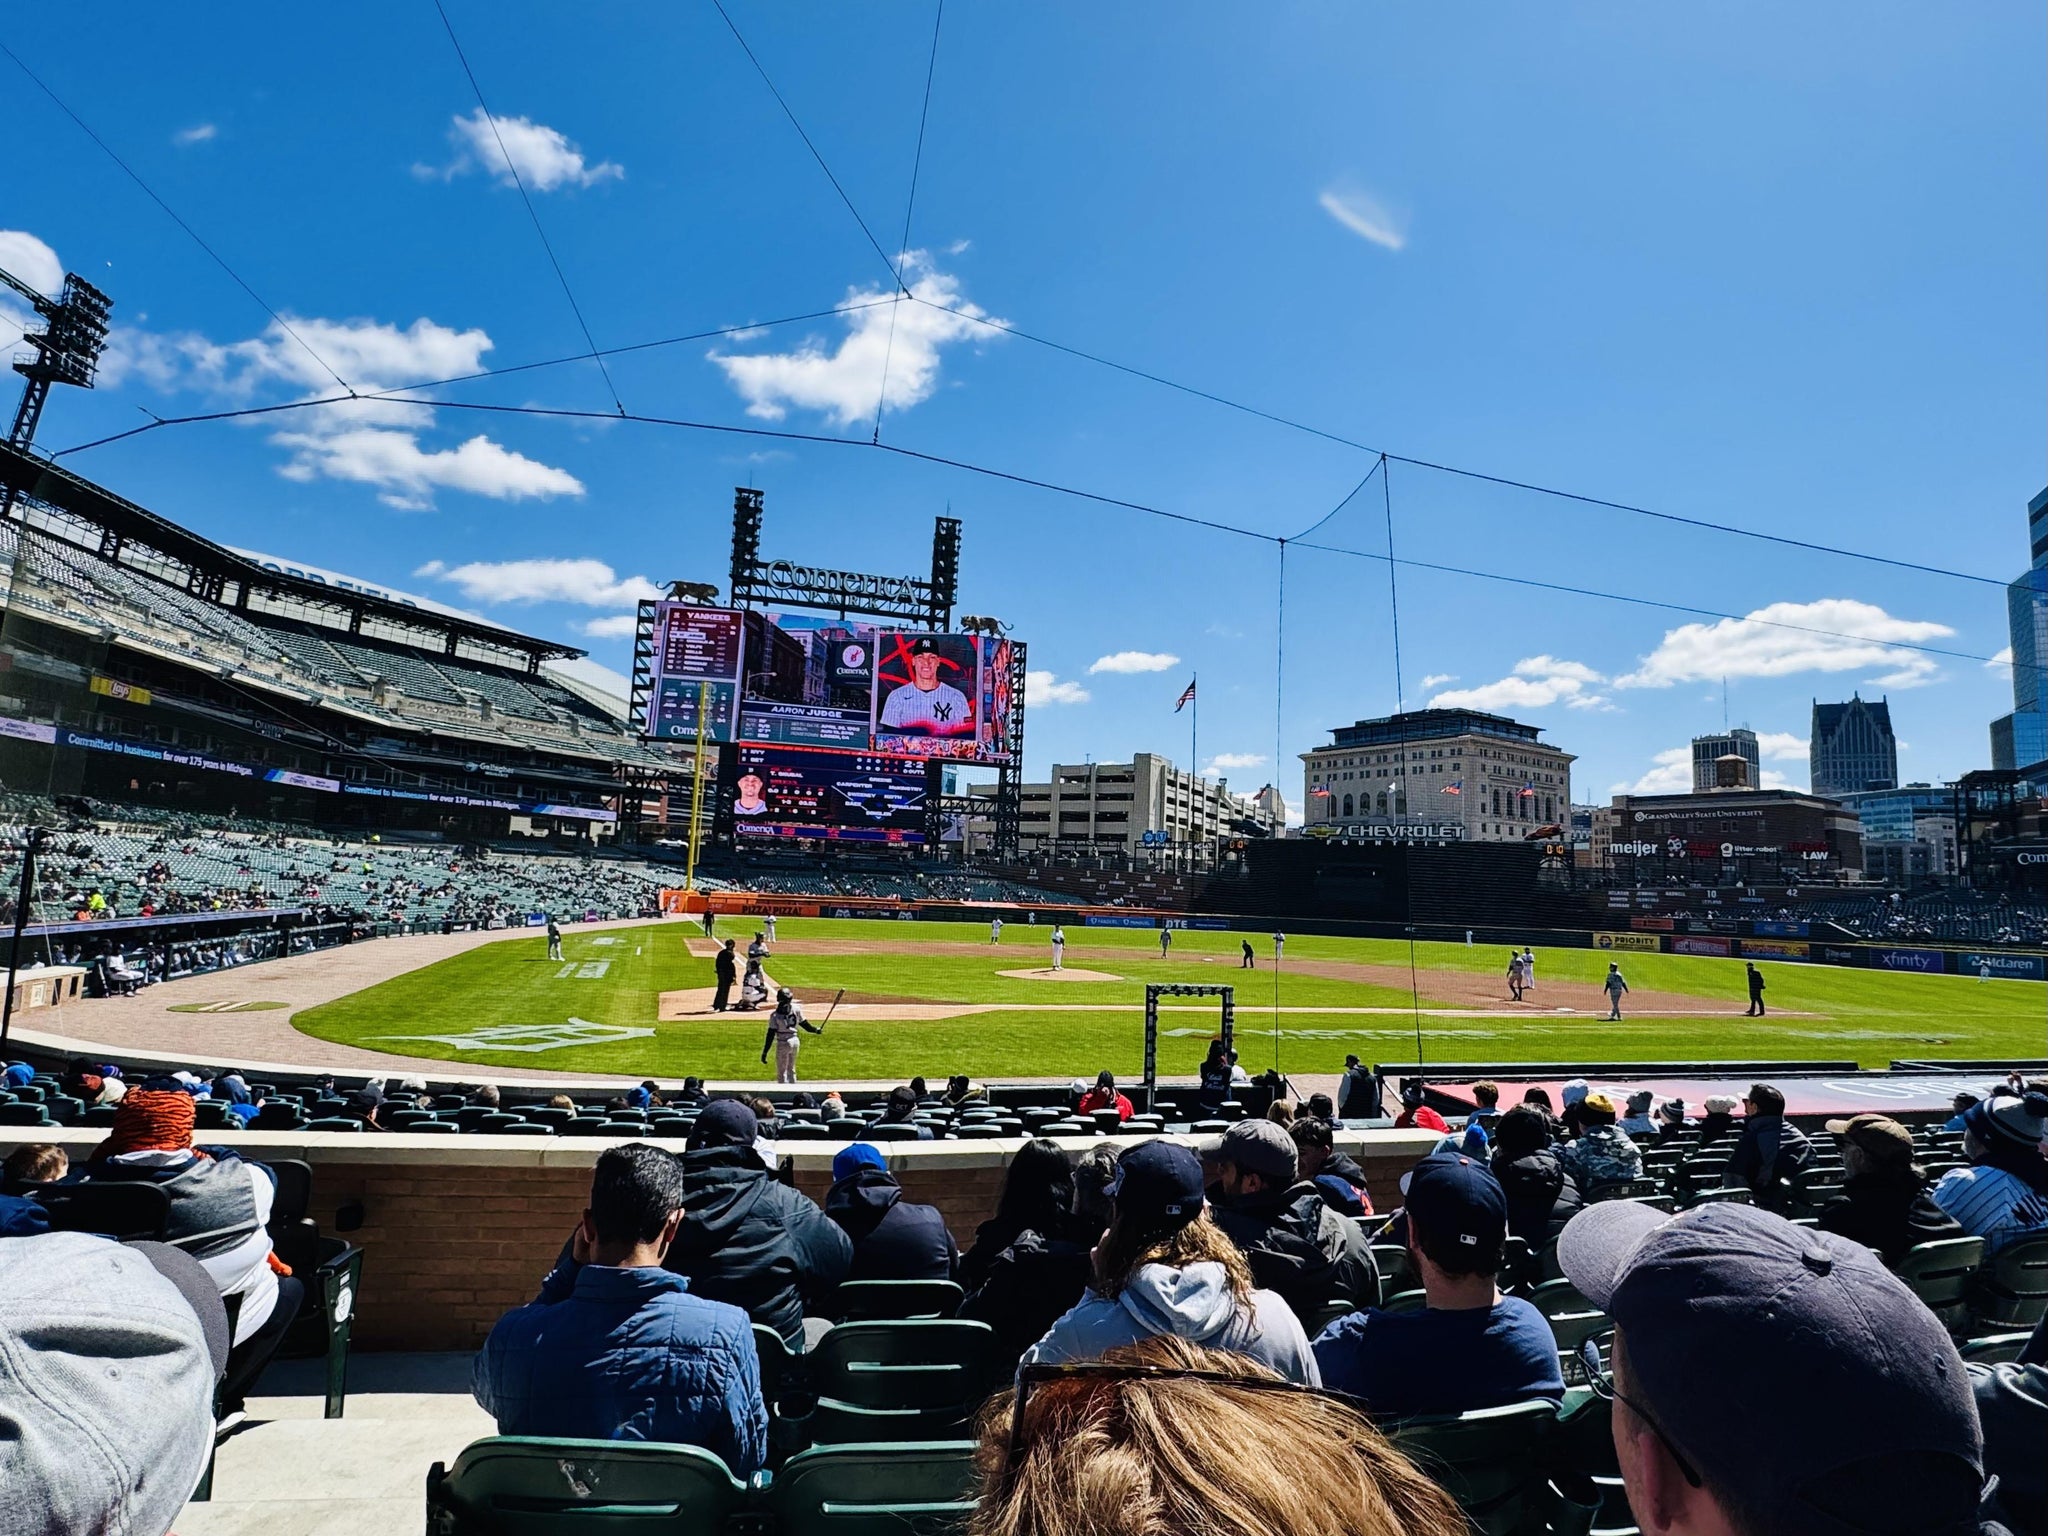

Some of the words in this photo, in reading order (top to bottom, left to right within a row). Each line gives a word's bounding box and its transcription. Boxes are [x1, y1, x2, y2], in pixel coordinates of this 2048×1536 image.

[809, 590, 879, 608] PARK
[687, 612, 731, 621] YANKEES
[771, 706, 805, 715] AARON
[806, 709, 842, 718] JUDGE
[933, 701, 953, 722] NY
[68, 733, 113, 751] Committed
[114, 742, 123, 753] to
[123, 744, 162, 760] businesses
[163, 750, 173, 761] for
[173, 753, 189, 765] over
[189, 755, 202, 767] 175
[202, 758, 219, 770] years
[226, 763, 253, 776] Michigan.
[344, 784, 382, 796] Committed
[382, 787, 391, 796] to
[391, 787, 428, 801] businesses
[429, 793, 439, 801] for
[439, 795, 454, 803] over
[455, 796, 468, 805] 175
[468, 798, 486, 808] years
[1695, 811, 1717, 819] STATE
[1717, 810, 1763, 818] UNIVERSITY
[1347, 825, 1465, 839] CHEVROLET
[1326, 839, 1447, 848] FOUNTAIN
[1610, 840, 1658, 857] meijer
[1803, 851, 1829, 860] LAW
[1707, 889, 1717, 899] 10
[1747, 888, 1756, 897] 11
[1786, 888, 1799, 897] 42
[742, 905, 770, 914] PIZZA!
[771, 906, 801, 915] PIZZA!
[1165, 919, 1188, 929] DTE
[1614, 936, 1655, 945] PRIORITY
[1882, 951, 1930, 969] xfinity
[1987, 957, 2033, 970] McLaren
